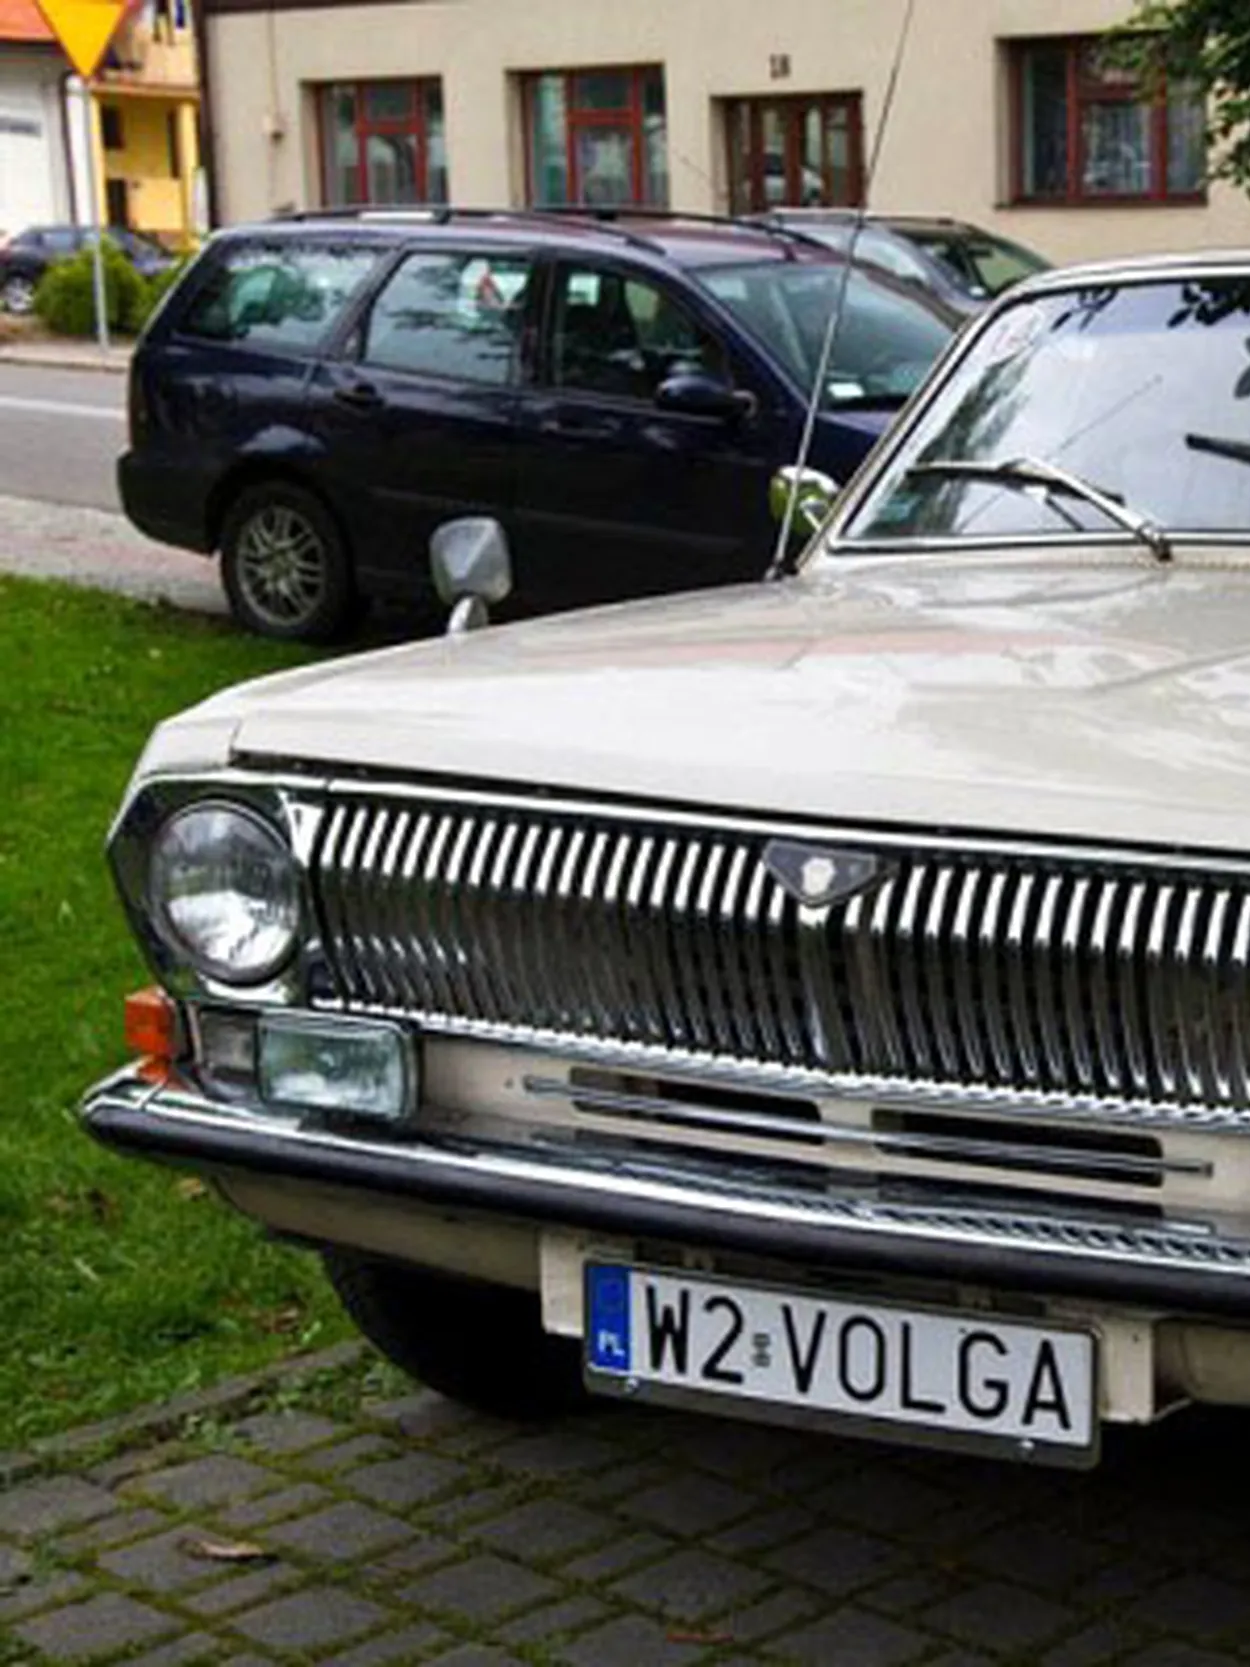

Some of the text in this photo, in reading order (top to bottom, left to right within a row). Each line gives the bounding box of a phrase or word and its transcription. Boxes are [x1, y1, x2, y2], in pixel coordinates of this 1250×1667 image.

[598, 1328, 626, 1357] PL
[645, 1284, 1072, 1431] W2 VOLGA
